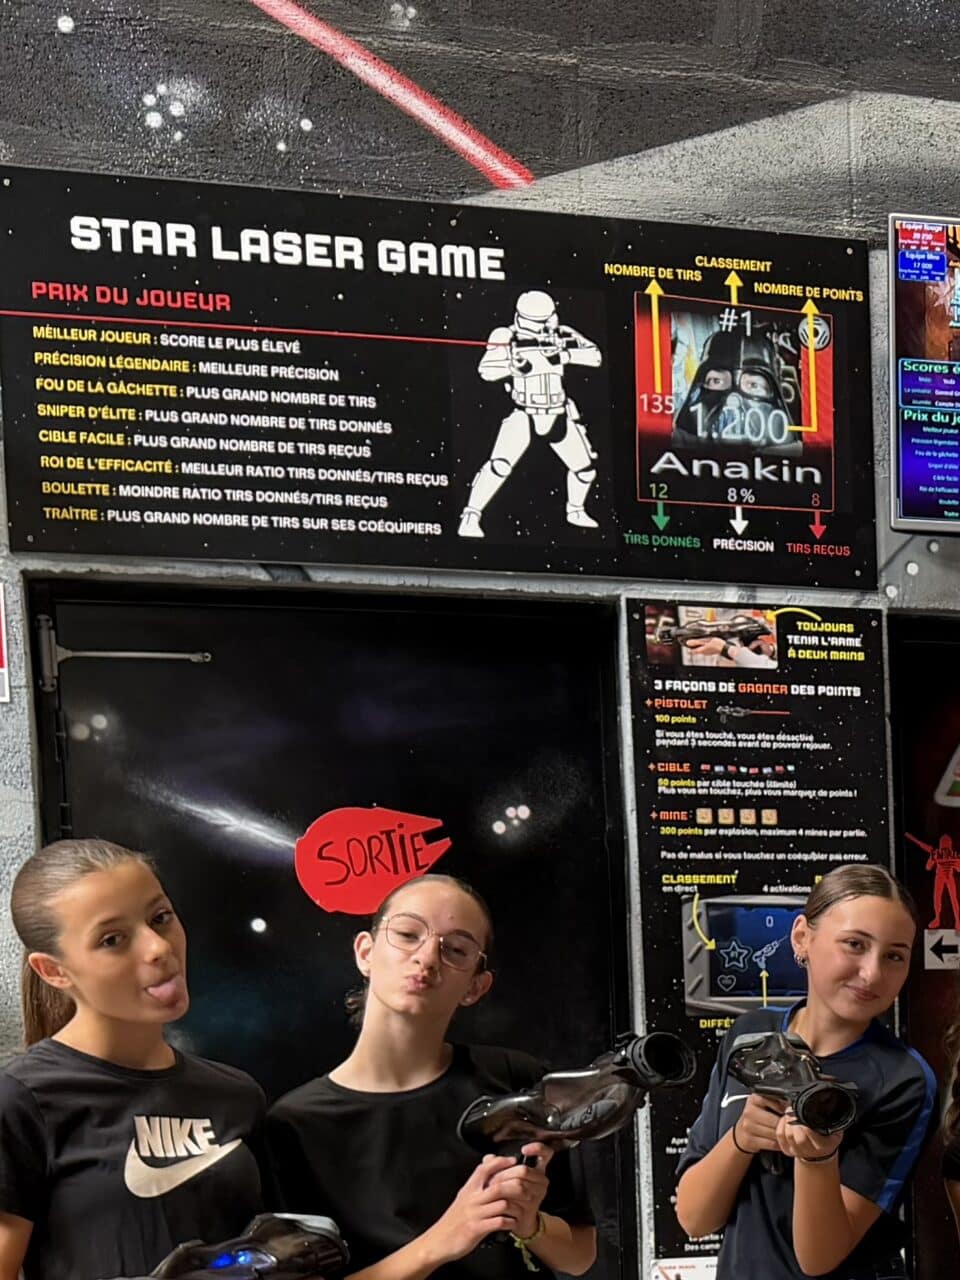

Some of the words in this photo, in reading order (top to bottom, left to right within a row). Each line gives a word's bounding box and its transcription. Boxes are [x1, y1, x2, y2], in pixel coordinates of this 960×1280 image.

[70, 216, 197, 259] STAR
[211, 226, 364, 270] LASER
[377, 239, 506, 281] GAME
[604, 263, 655, 278] NOMBRE
[658, 267, 673, 279] DE
[676, 269, 702, 281] TIRS
[695, 256, 772, 273] CLASSEMENT
[31, 281, 89, 302] PRIX
[96, 285, 129, 306] DU
[136, 288, 231, 312] JOUEUR
[754, 282, 803, 296] NOMBRE
[805, 286, 820, 298] DE
[823, 288, 863, 301] POINTS
[719, 308, 752, 336] #1
[33, 325, 97, 341] MEILLEUR
[100, 330, 151, 344] JOUEUR
[160, 334, 205, 348] SCORE
[208, 337, 223, 349] LE
[226, 338, 259, 351] PLUS
[262, 338, 300, 354] ÉLEVÉ
[34, 351, 106, 368] PRÉCISION
[109, 355, 190, 372] LÉGENDAIRE
[199, 361, 268, 377] MEILLEURE
[271, 363, 339, 381] PRÉCISION
[903, 361, 949, 374] Scores
[36, 378, 64, 391] FOU
[67, 380, 84, 392] DE
[88, 381, 104, 393] LA
[107, 381, 177, 397] GÂCHETTE
[187, 386, 219, 399] PLUS
[222, 388, 268, 402] GRAND
[271, 391, 326, 405] NOMBRE
[329, 395, 345, 406] DE
[348, 396, 376, 408] TIRS
[38, 404, 85, 417] SNIPER
[145, 410, 178, 422] PLUS
[181, 412, 228, 425] GRAND
[231, 414, 286, 428] NOMBRE
[289, 417, 305, 429] DE
[308, 419, 336, 430] TIRS
[339, 420, 392, 434] DONNÉS
[640, 393, 675, 414] 135
[689, 403, 788, 444] 1.200
[903, 410, 928, 422] Prix
[932, 411, 949, 423] du
[39, 430, 76, 443] CIBLE
[80, 432, 124, 445] FACILE
[134, 435, 167, 447] PLUS
[171, 437, 217, 449] GRAND
[220, 439, 275, 453] NOMBRE
[278, 442, 294, 453] DE
[297, 443, 325, 455] TIRS
[329, 445, 371, 460] REÇUS
[41, 456, 64, 468] ROI
[67, 457, 84, 469] DE
[182, 463, 243, 476] MEILLEUR
[246, 465, 284, 478] RATIO
[287, 467, 315, 479] TIRS
[407, 473, 449, 489] REÇUS
[650, 452, 822, 484] Anakin
[42, 481, 110, 496] BOULETTE
[119, 484, 180, 499] MOINDRE
[182, 487, 222, 501] RATIO
[224, 489, 254, 502] TIRS
[345, 494, 388, 511] REÇUS
[649, 483, 668, 498] 12
[812, 493, 820, 506] 8
[43, 506, 98, 521] TRAÎTRE
[107, 510, 141, 522] PLUS
[143, 511, 191, 524] GRAND
[193, 513, 249, 527] NOMBRE
[251, 515, 269, 528] DE
[271, 516, 300, 529] TIRS
[302, 518, 328, 530] SUR
[331, 519, 356, 531] SES
[358, 519, 442, 535] COÉQUIPIERS
[624, 533, 649, 546] TIRS
[652, 534, 701, 548] DONNÉS
[713, 537, 774, 552] PRÉCISION
[786, 543, 811, 555] TIRS
[814, 545, 850, 557] REÇUS
[796, 621, 854, 633] TOUJOURS
[787, 635, 819, 646] TENIR
[821, 636, 863, 647] L'ARME
[788, 648, 796, 659] À
[798, 650, 828, 660] DEUX
[830, 651, 865, 662] MAINS
[654, 680, 662, 691] 3
[665, 680, 716, 693] FAÇONS
[719, 682, 736, 693] DE
[738, 683, 788, 695] GAGNER
[790, 684, 815, 696] DES
[818, 685, 861, 697] POINTS
[654, 698, 708, 710] PISTOLET
[655, 714, 669, 723] 100
[671, 715, 697, 725] points
[657, 762, 691, 772] CIBLE
[660, 810, 688, 821] MINE
[317, 823, 430, 886] SORTIE
[662, 874, 737, 884] CLASSEMENT
[675, 884, 698, 893] direct
[134, 1115, 221, 1158] NIKE
